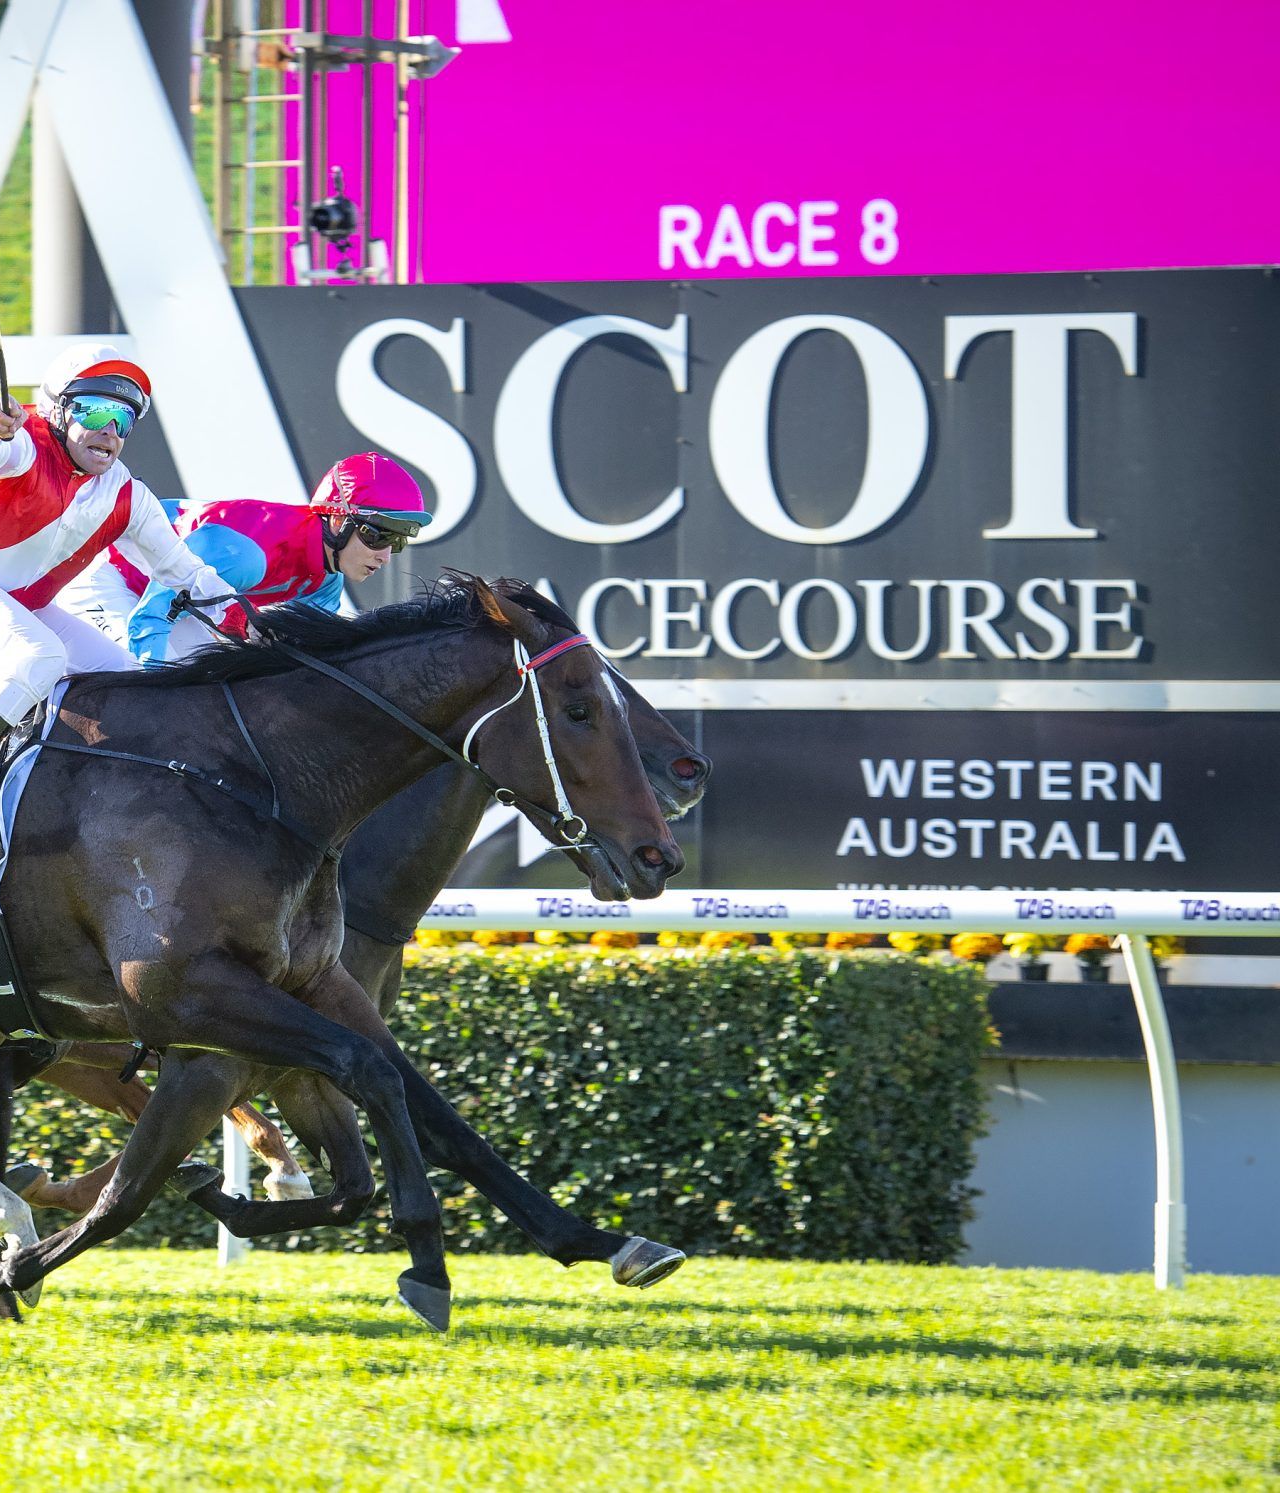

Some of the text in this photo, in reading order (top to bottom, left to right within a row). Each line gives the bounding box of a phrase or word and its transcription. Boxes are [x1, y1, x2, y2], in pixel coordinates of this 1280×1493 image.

[658, 198, 900, 270] RACE 8
[534, 577, 1144, 661] CECOURSE
[860, 758, 1162, 801] WESTERN
[835, 817, 1186, 862] AUSTRALIA
